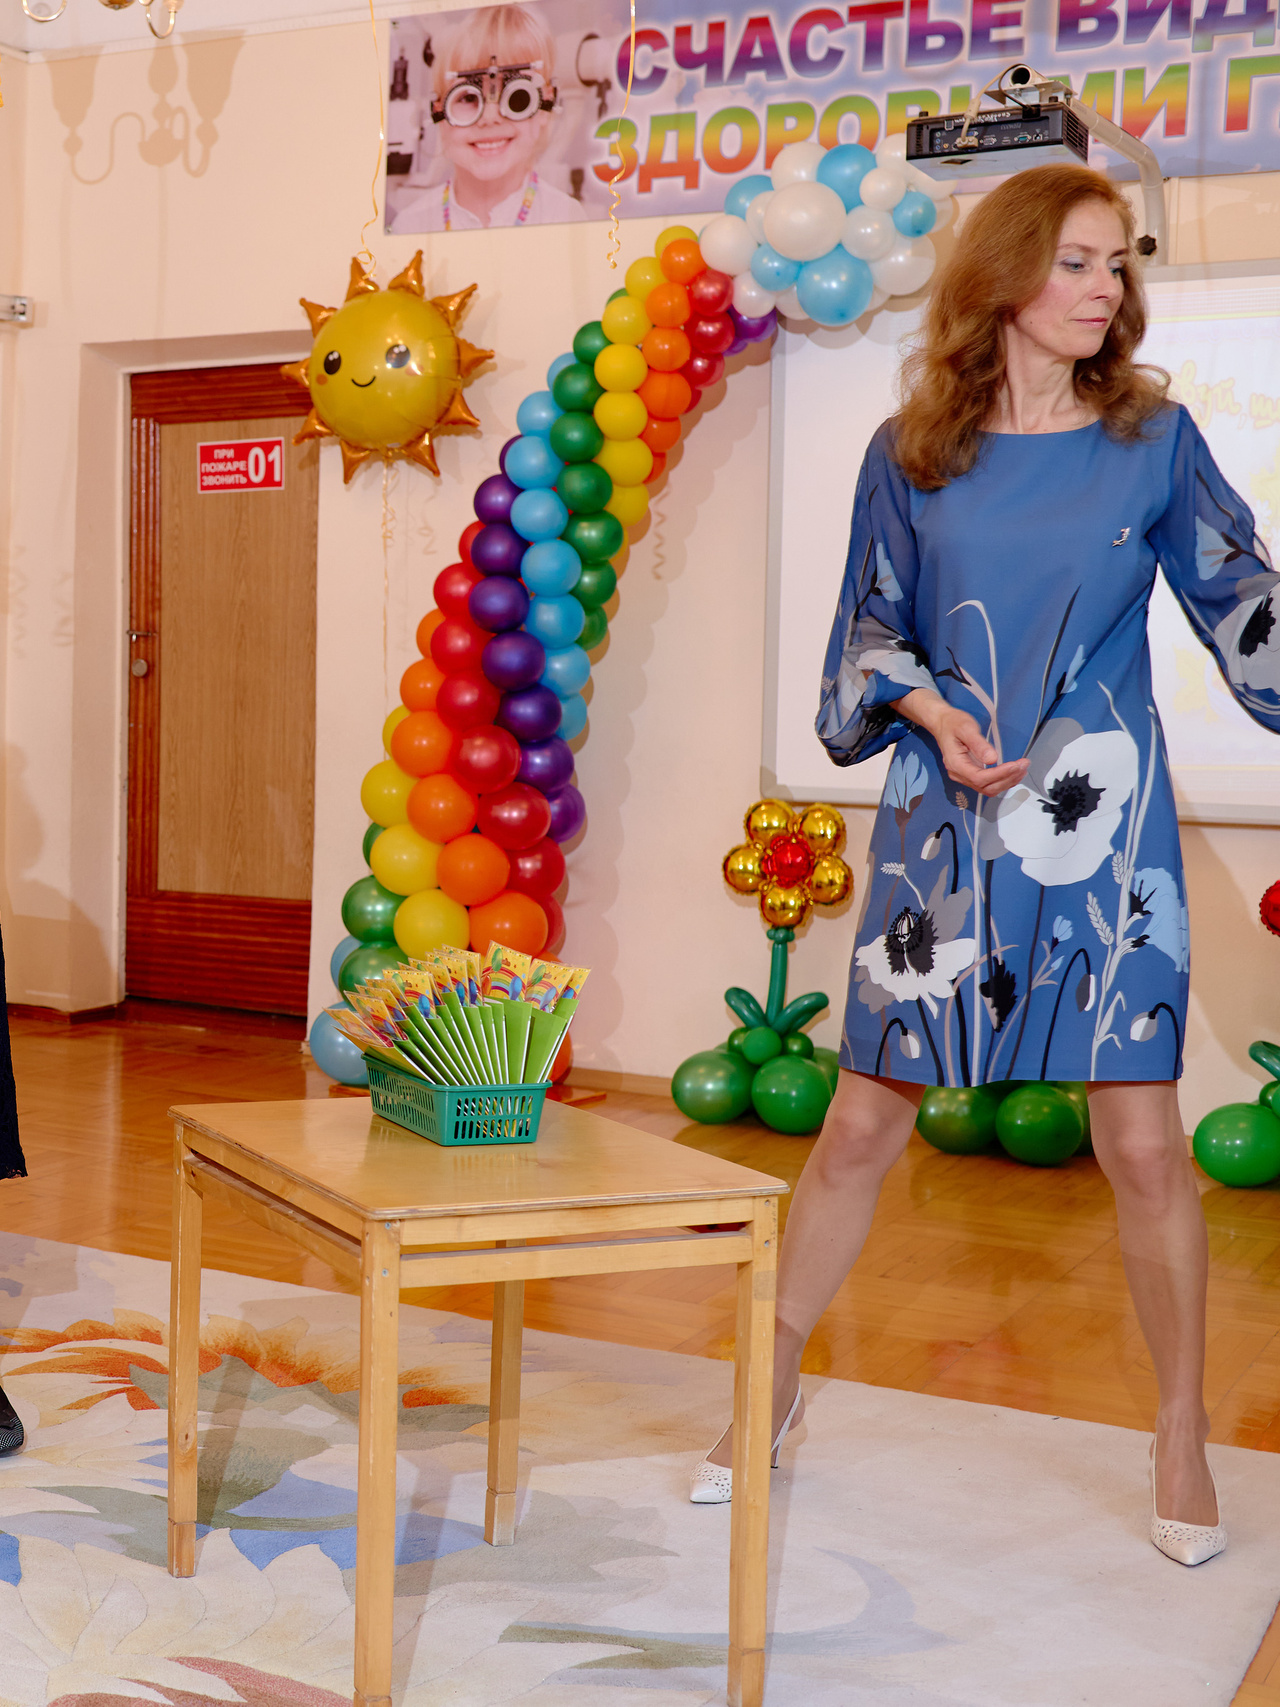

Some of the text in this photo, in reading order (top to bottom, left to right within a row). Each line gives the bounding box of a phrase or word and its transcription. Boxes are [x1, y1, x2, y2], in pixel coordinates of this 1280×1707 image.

[616, 0, 1024, 96] СЧАСТЬЕ
[213, 448, 235, 460] ПРИ
[201, 460, 248, 473] ПОЖАРЕ
[248, 446, 282, 483] 01
[202, 474, 247, 486] ЗВОНИТЬ
